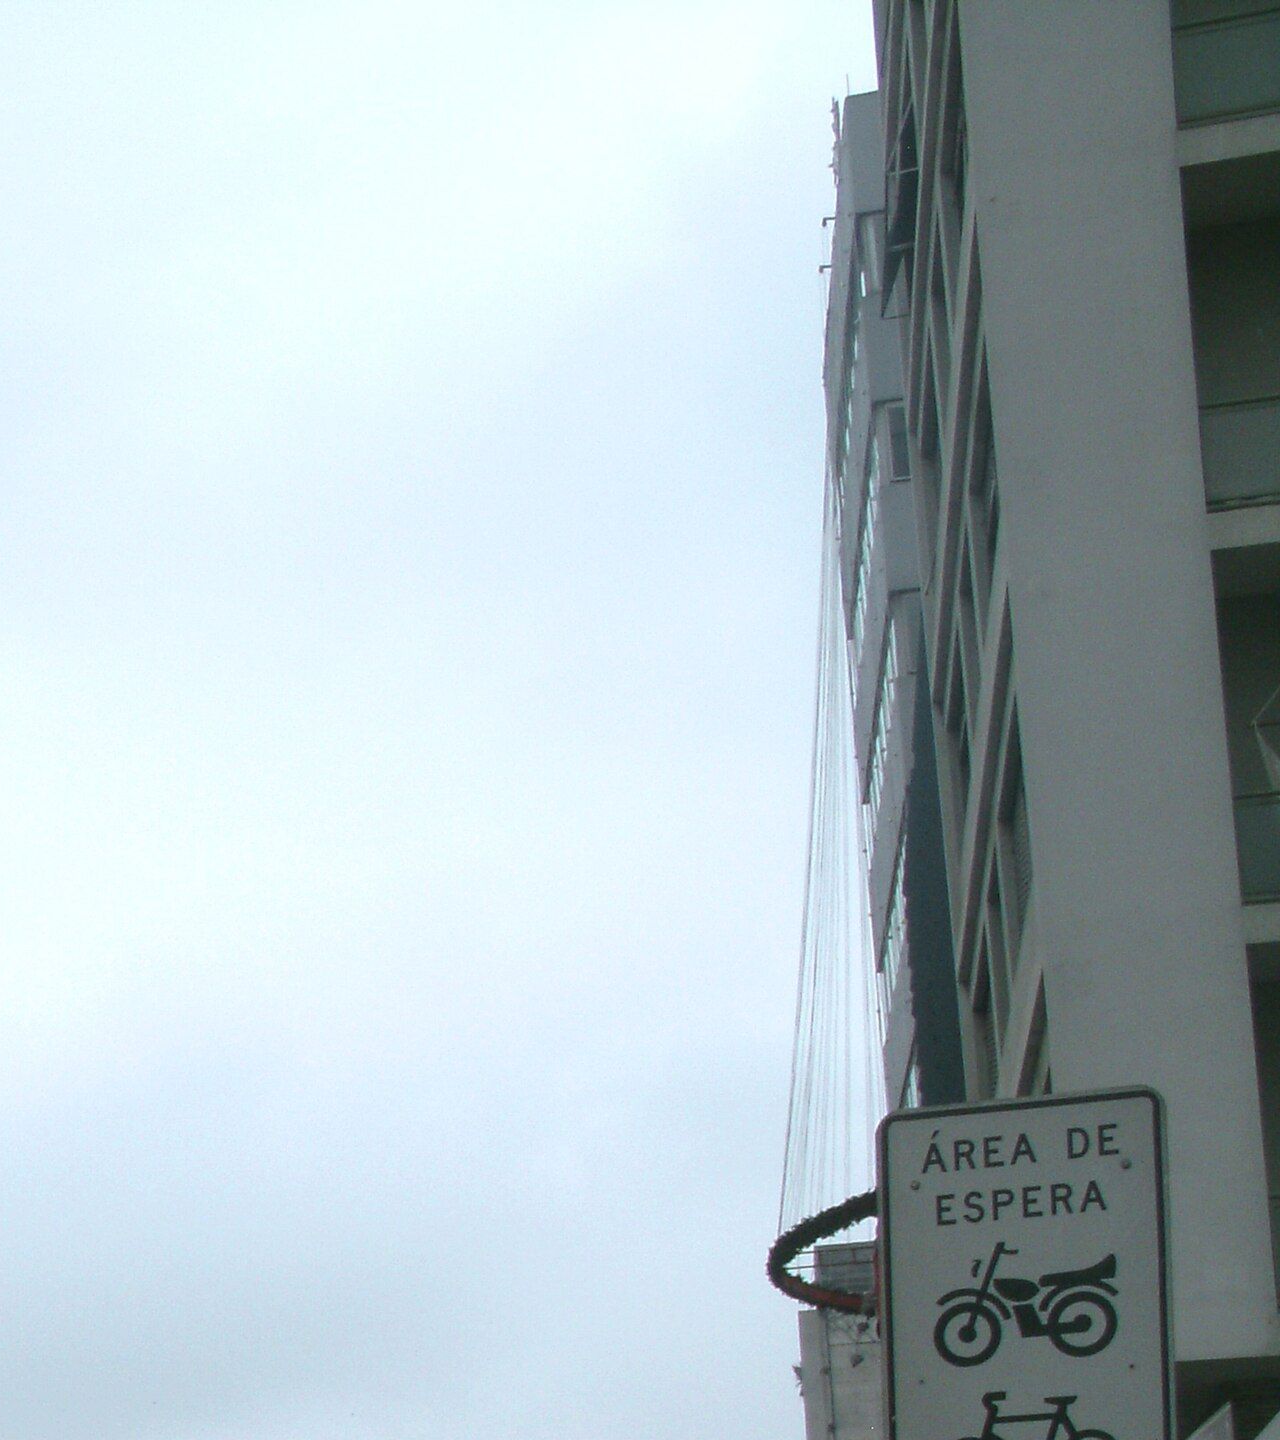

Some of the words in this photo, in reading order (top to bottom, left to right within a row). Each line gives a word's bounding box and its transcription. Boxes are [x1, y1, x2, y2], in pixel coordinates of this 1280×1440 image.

[921, 1129, 1037, 1174] ÁREA
[1066, 1123, 1121, 1160] DE
[935, 1181, 1108, 1227] ESPERA
